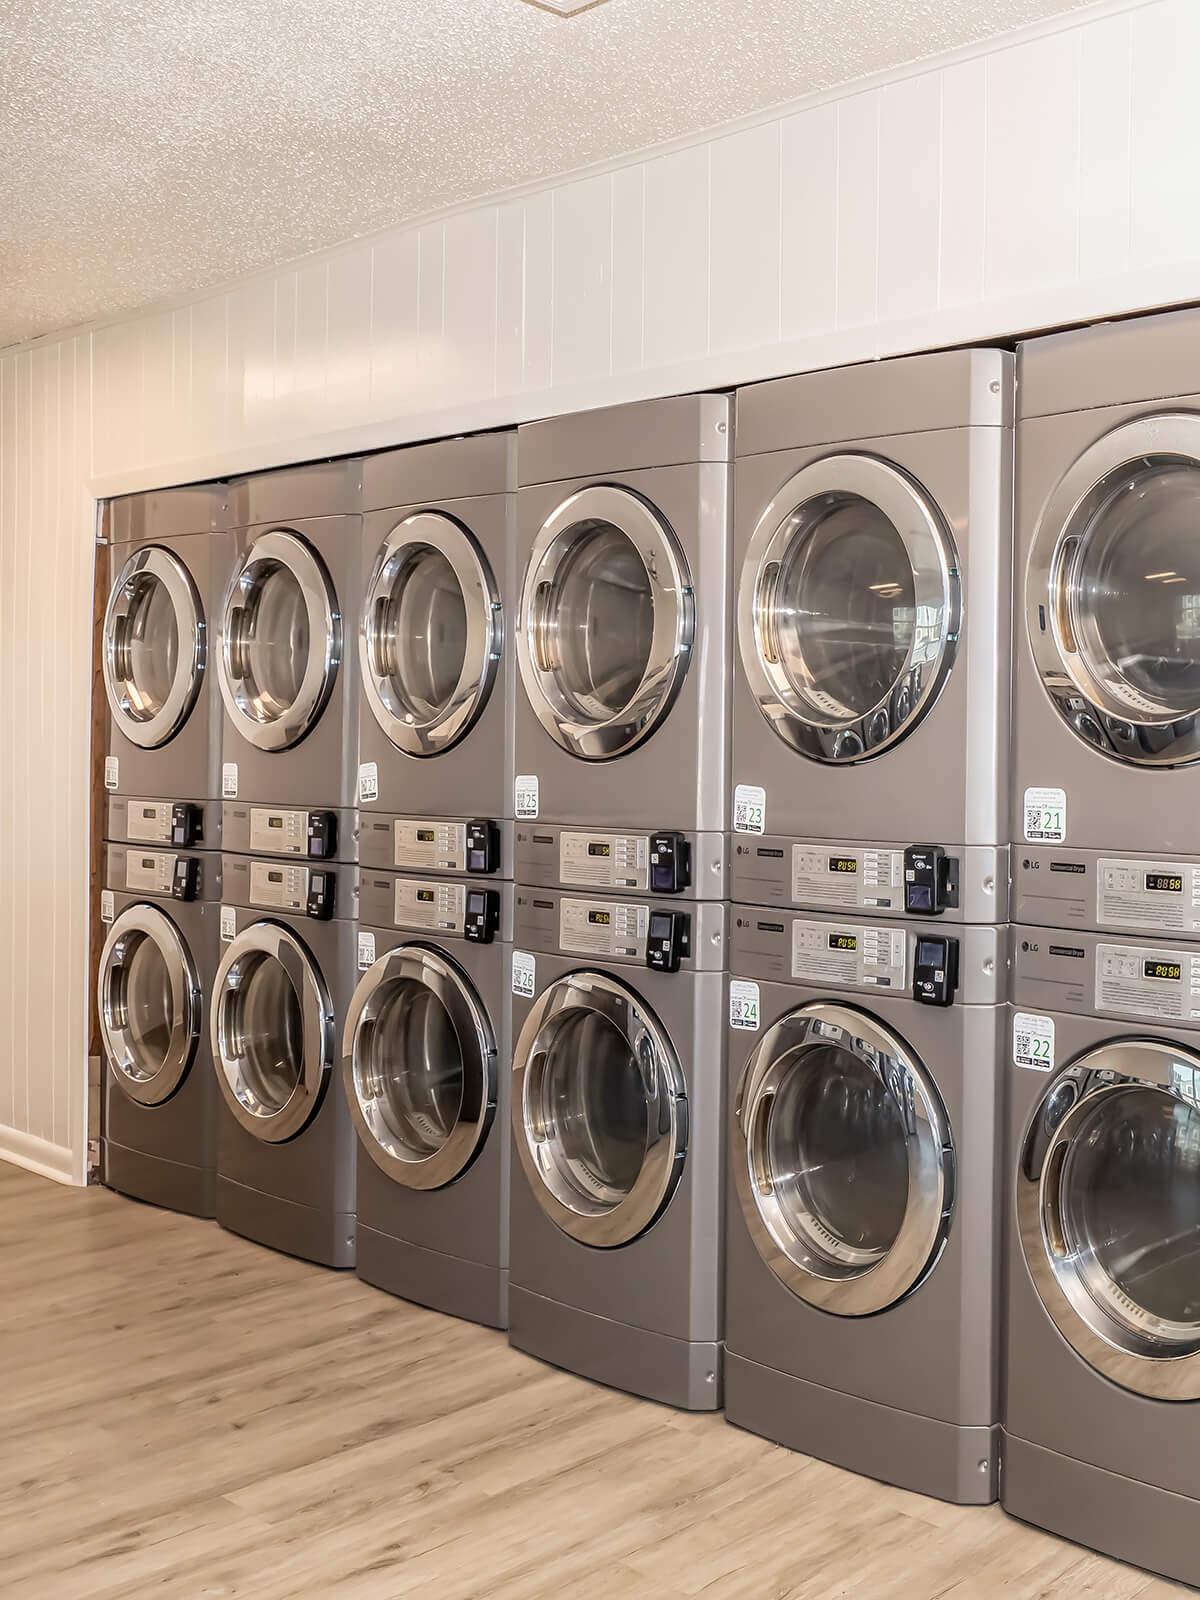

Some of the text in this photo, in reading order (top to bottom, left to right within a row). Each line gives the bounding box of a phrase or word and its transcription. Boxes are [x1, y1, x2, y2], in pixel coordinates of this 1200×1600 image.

[526, 793, 537, 808] 25
[748, 807, 762, 824] 23
[1043, 811, 1062, 830] 21
[1030, 944, 1039, 952] LG
[522, 973, 534, 988] 26
[743, 1003, 758, 1019] 24
[1032, 1039, 1050, 1058] 22
